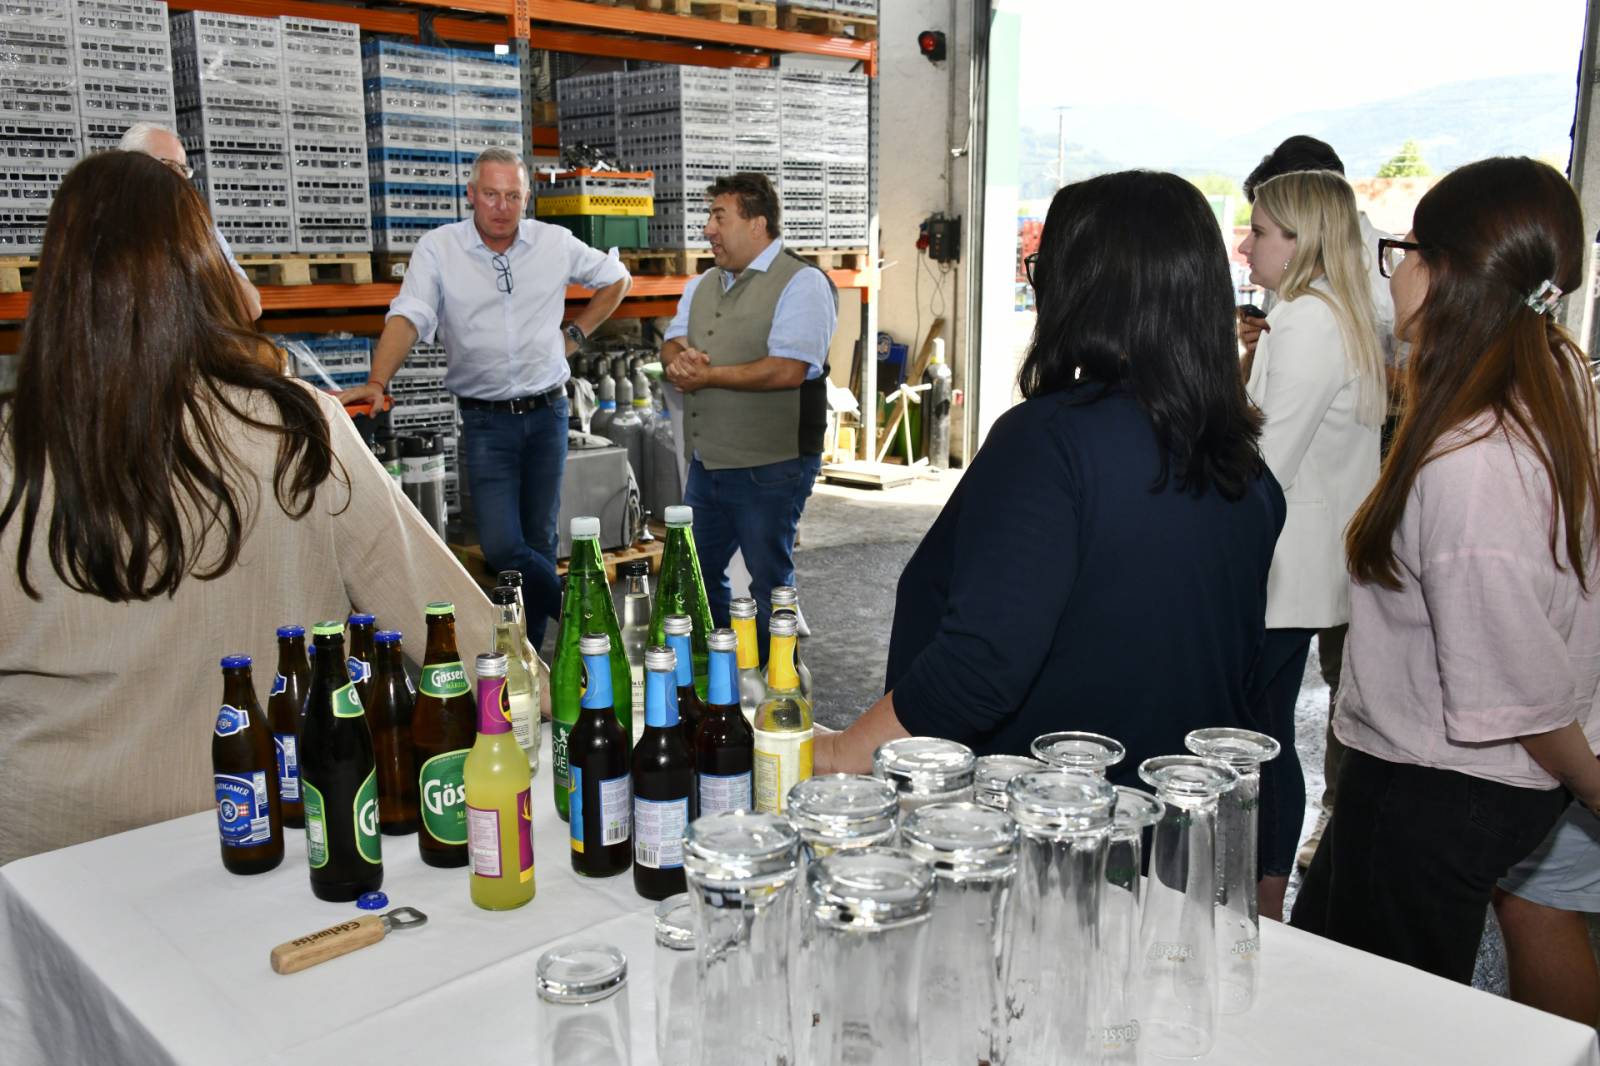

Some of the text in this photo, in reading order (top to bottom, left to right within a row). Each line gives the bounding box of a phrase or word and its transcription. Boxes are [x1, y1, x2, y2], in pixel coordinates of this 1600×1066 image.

[431, 670, 464, 688] Gösser
[424, 779, 466, 816] Gös
[292, 921, 361, 947] Edelweiss
